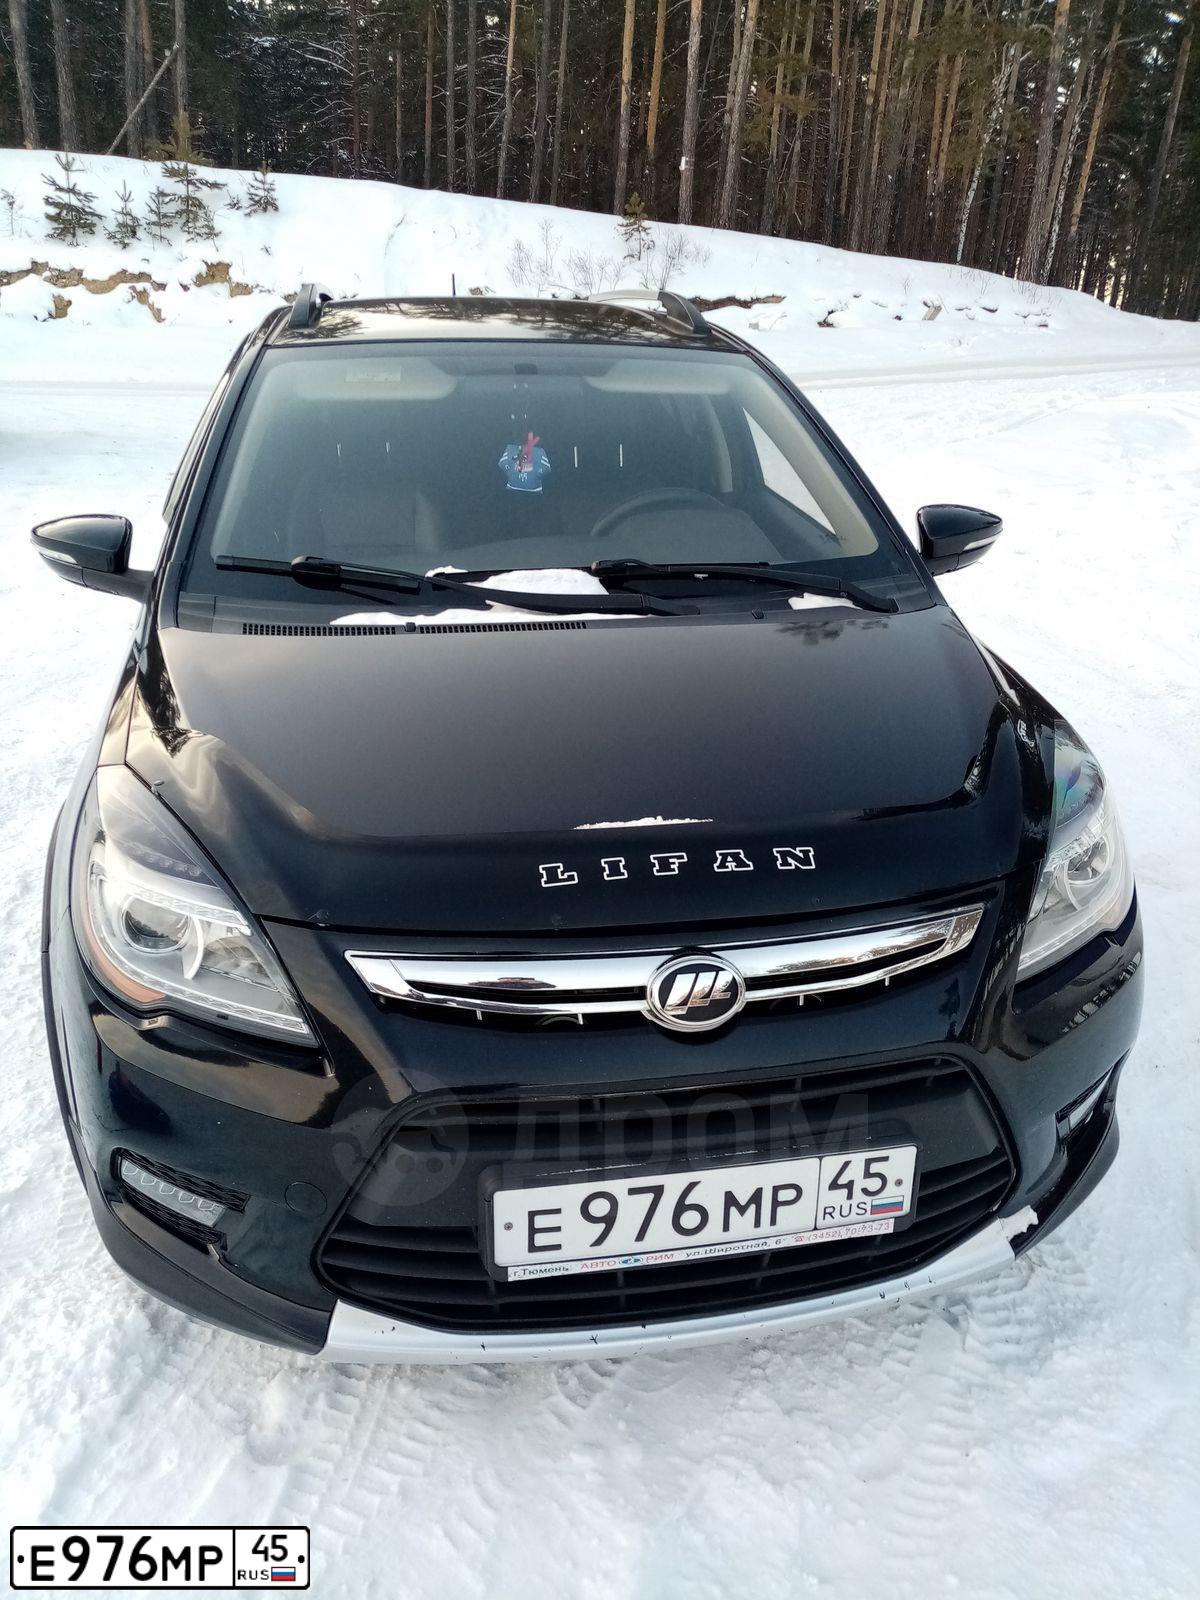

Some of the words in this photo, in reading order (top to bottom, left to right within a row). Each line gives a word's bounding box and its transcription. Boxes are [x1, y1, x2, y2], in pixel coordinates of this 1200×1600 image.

[539, 847, 816, 887] LIFAN
[827, 1155, 890, 1201] 45
[822, 1201, 868, 1221] RUS
[580, 1259, 617, 1270] АВТО
[646, 1252, 676, 1264] РИМ
